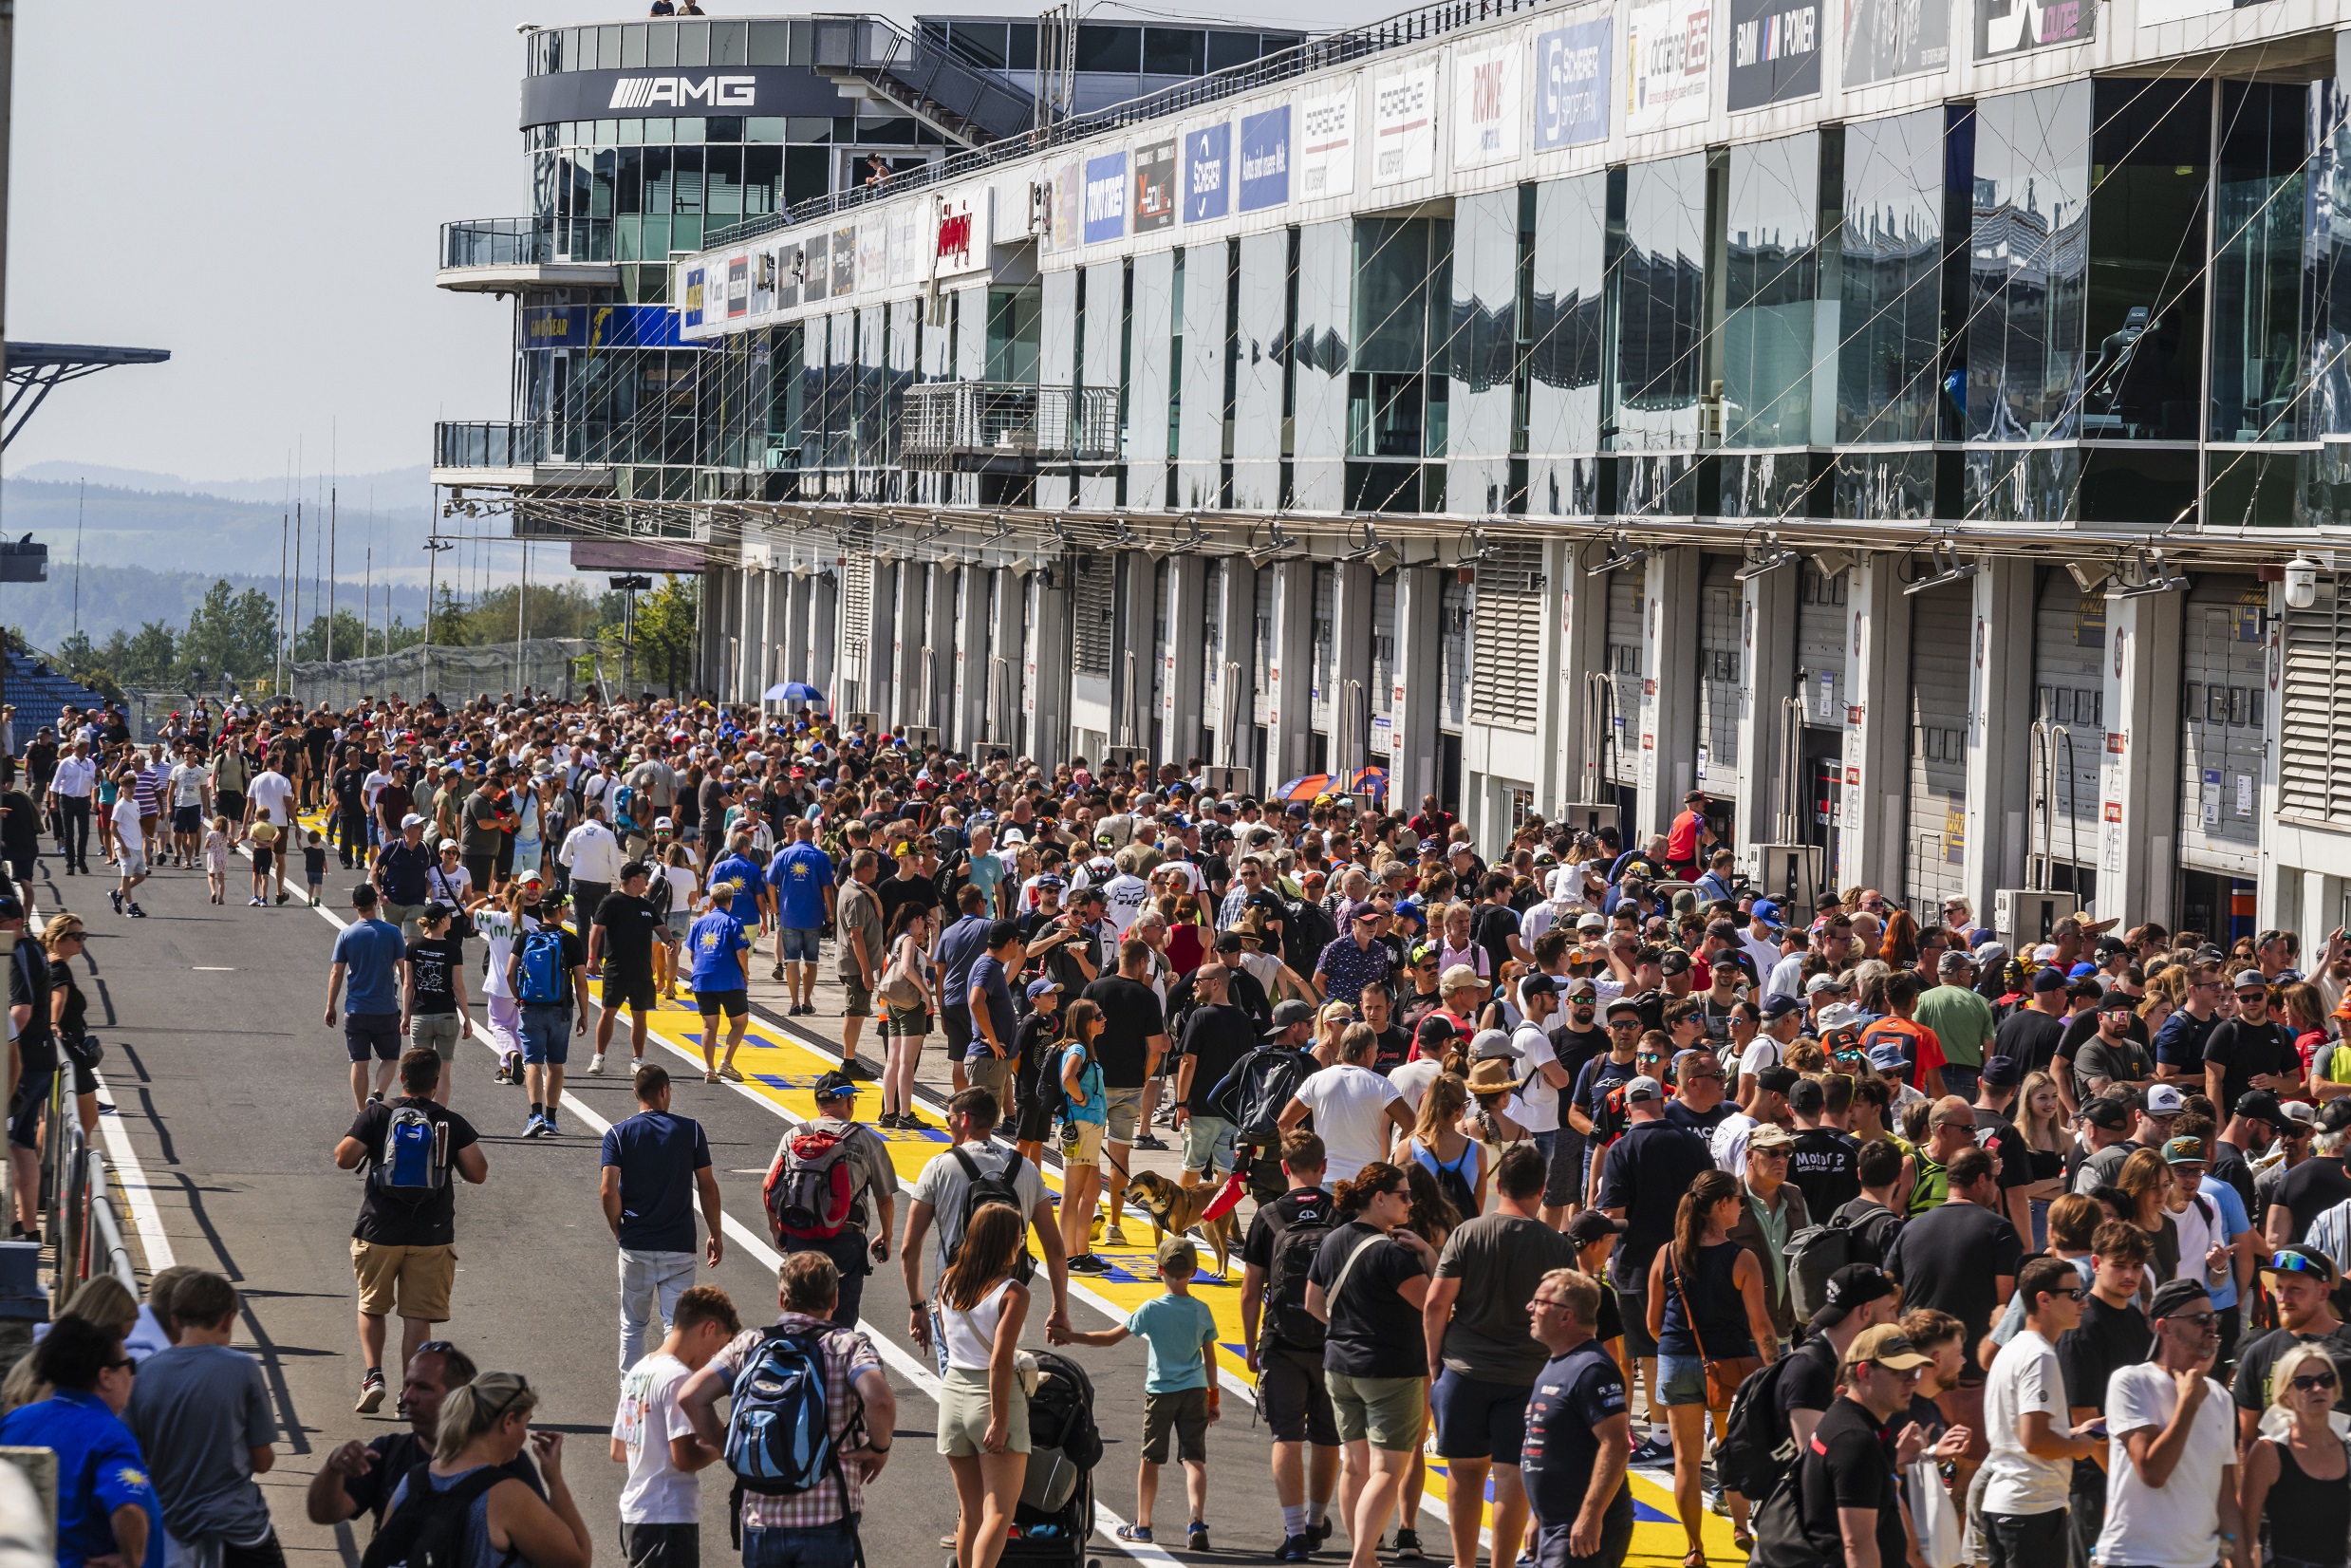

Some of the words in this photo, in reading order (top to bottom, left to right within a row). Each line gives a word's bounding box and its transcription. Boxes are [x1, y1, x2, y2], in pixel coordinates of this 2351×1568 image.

[1736, 19, 1759, 68] BMW
[1783, 5, 1816, 57] POWER
[1563, 46, 1598, 84] SCHERER
[645, 75, 756, 107] AMG
[1380, 81, 1424, 118] PORSCHE
[1472, 60, 1503, 124] ROWE
[1306, 103, 1346, 137] PORSCHE
[1193, 159, 1221, 195] SCHERER
[1087, 178, 1105, 223] TOYO
[1105, 174, 1124, 218] TIRES
